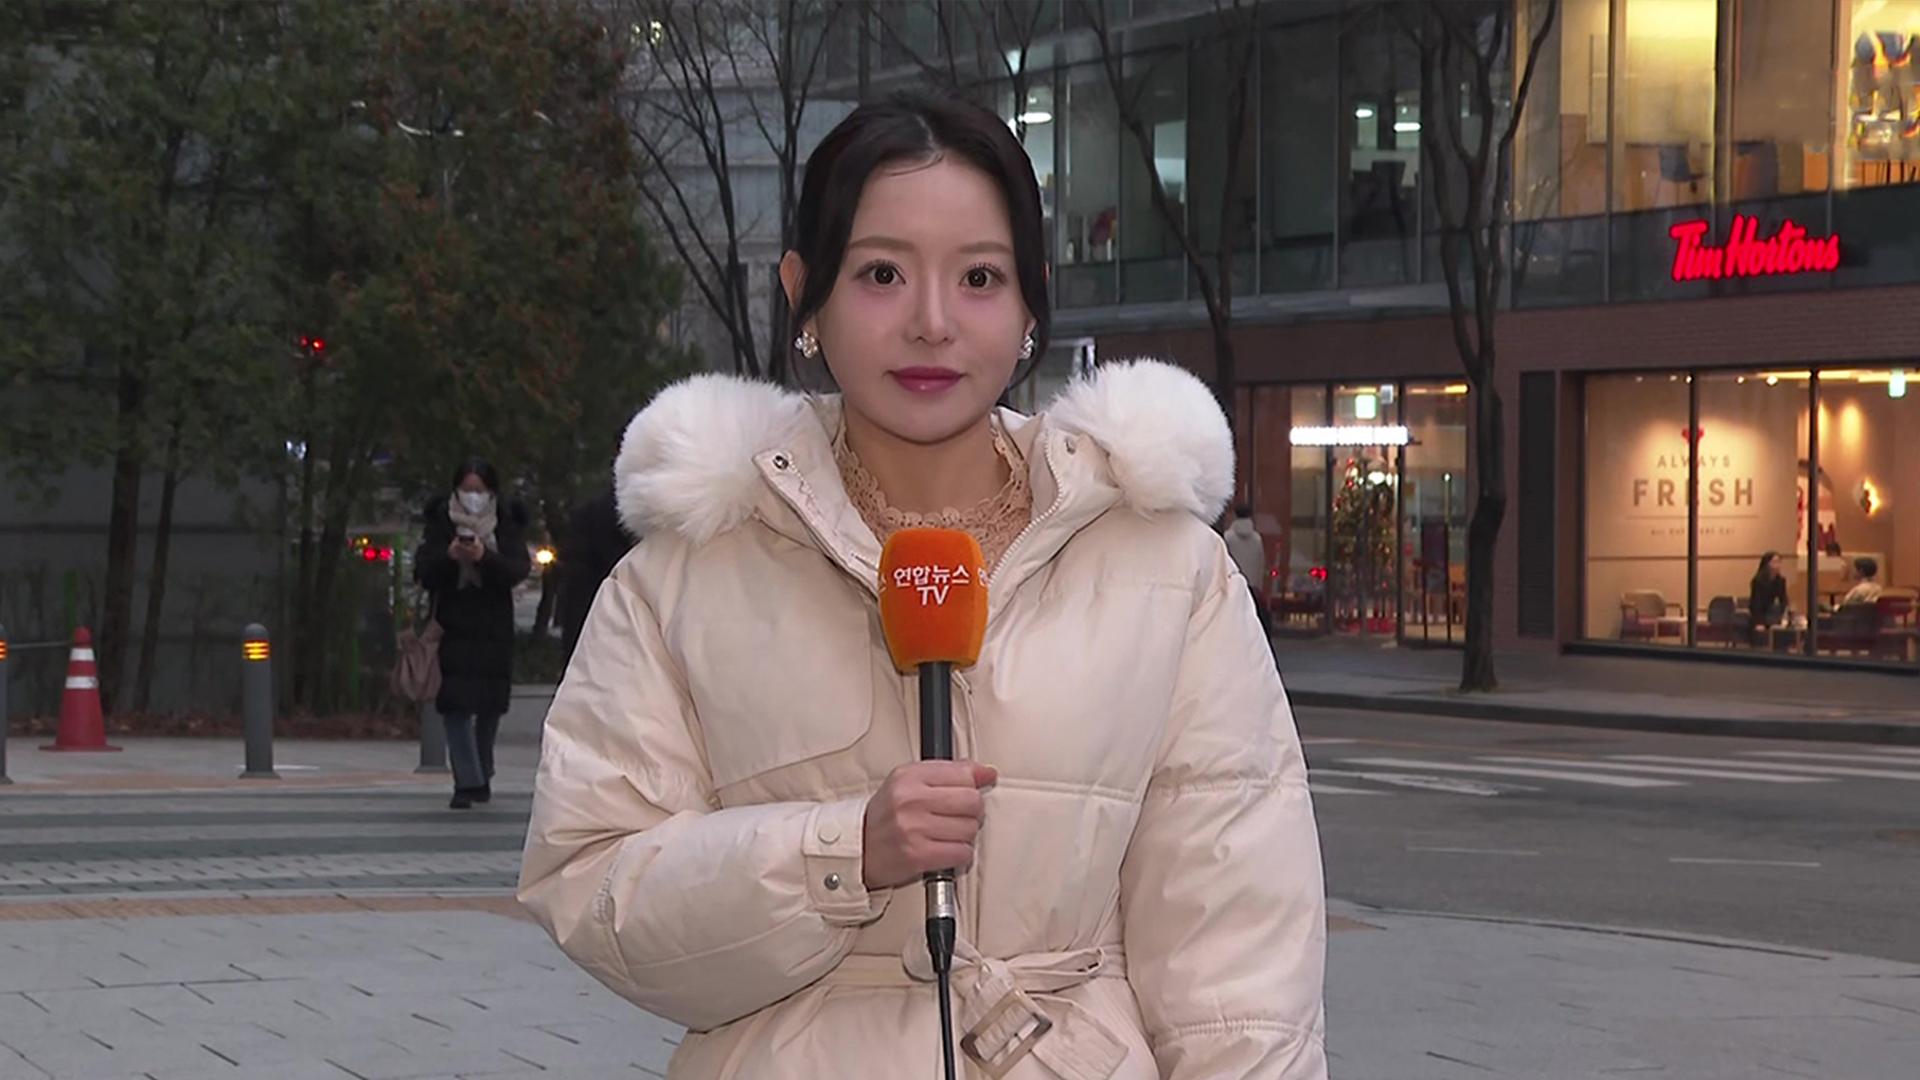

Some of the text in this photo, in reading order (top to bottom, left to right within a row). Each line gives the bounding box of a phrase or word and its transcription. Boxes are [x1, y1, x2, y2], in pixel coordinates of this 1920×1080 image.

[1670, 213, 1840, 282] Tim Hortons
[1632, 478, 1753, 507] FRSH
[893, 564, 970, 588] 연합뉴스
[916, 584, 950, 606] TV
